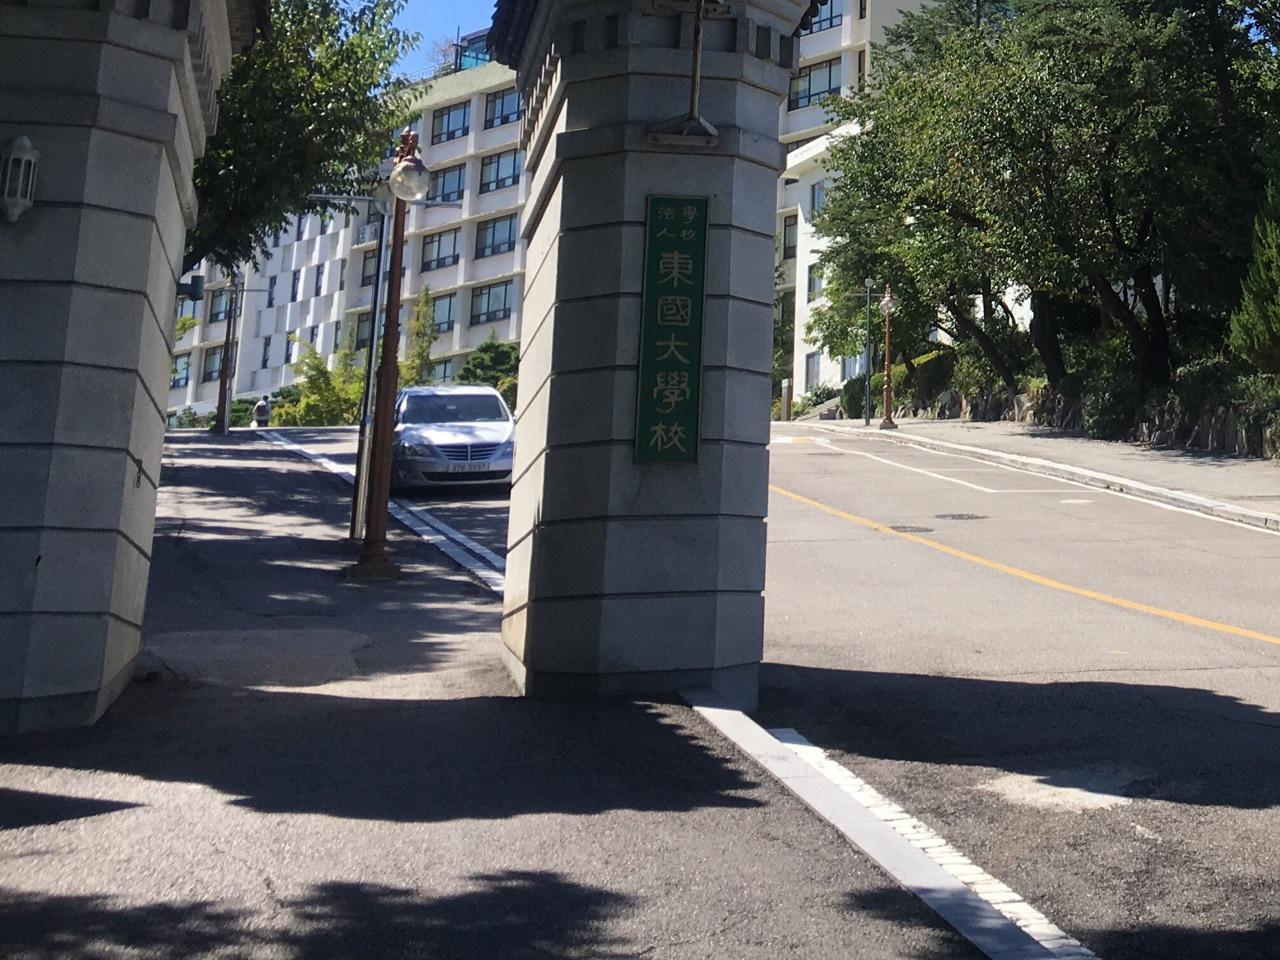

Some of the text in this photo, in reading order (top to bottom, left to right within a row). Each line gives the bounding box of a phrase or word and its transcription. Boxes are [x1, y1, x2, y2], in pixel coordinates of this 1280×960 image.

[649, 249, 694, 454] 東國大學校
